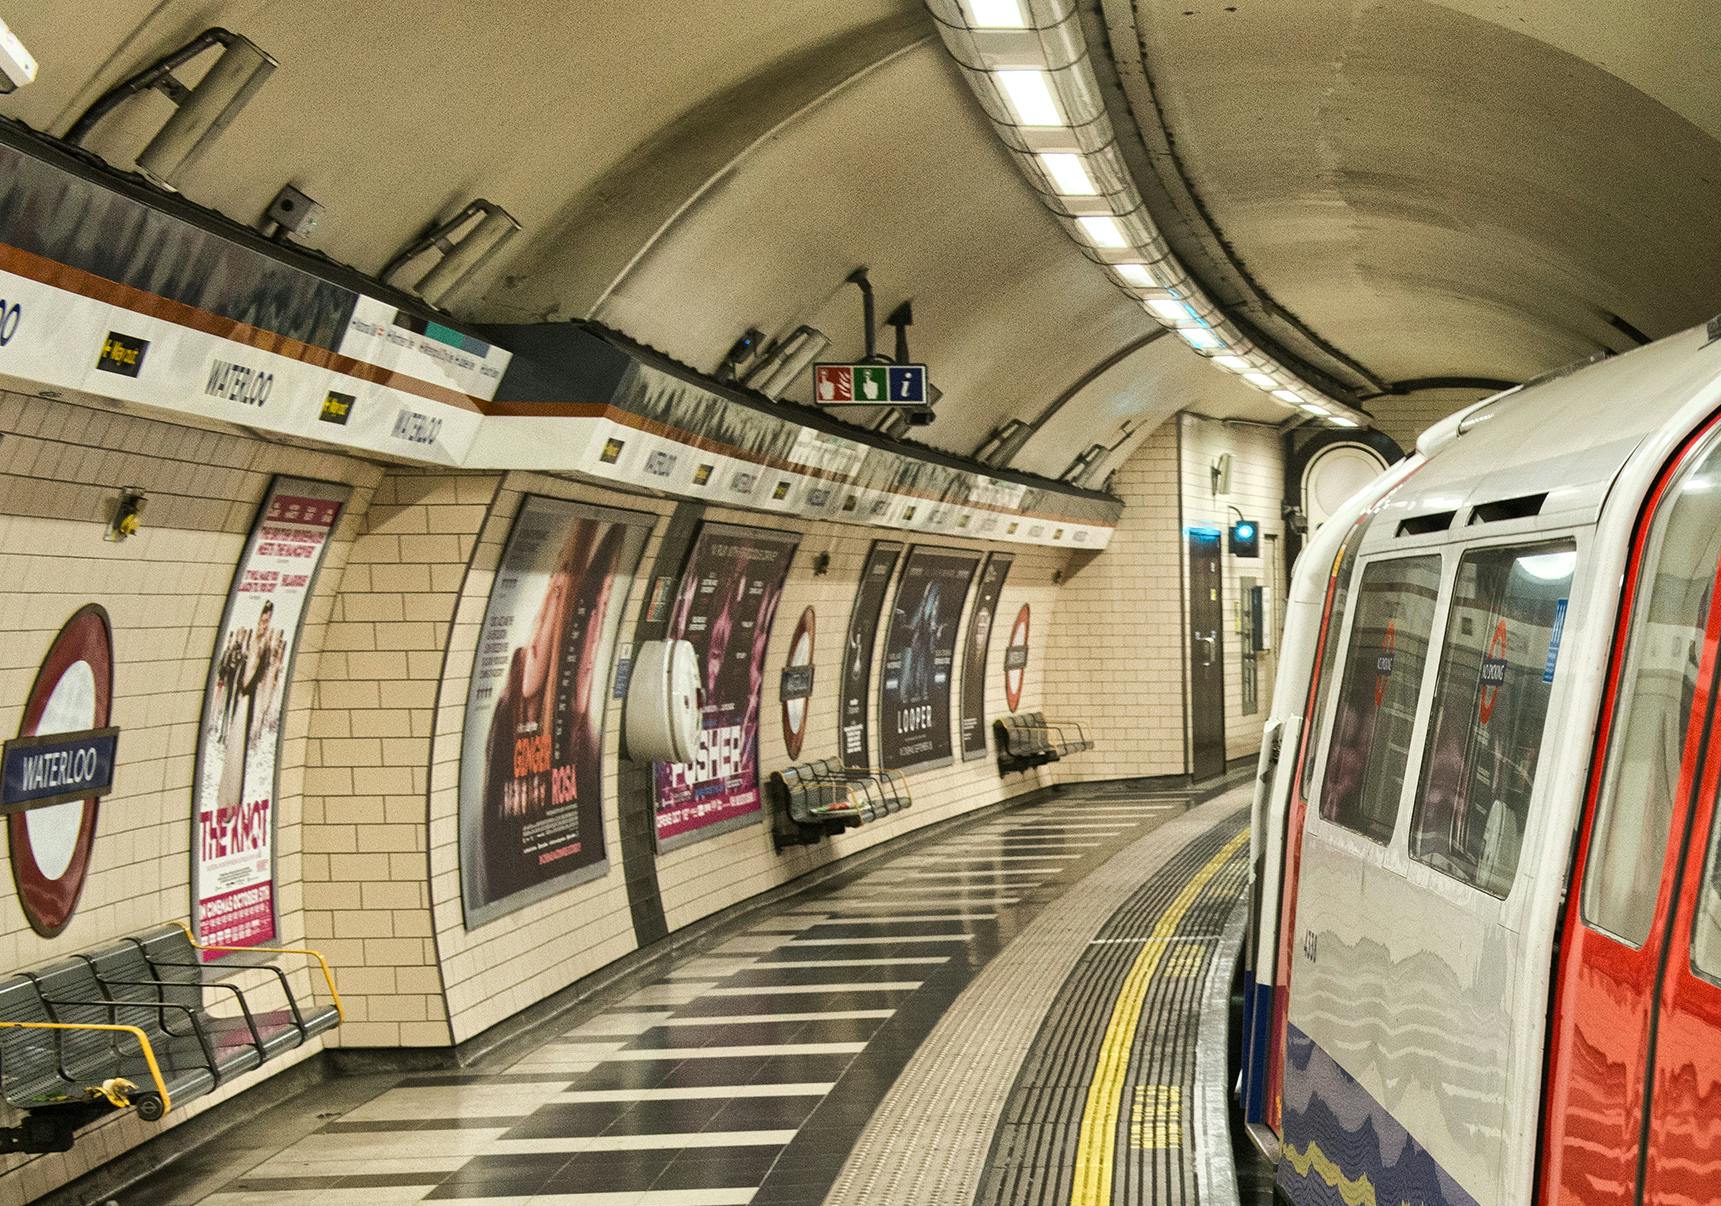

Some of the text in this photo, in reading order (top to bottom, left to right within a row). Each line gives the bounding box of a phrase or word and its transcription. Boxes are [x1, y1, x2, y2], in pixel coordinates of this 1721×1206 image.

[204, 358, 274, 407] WATERLOO
[391, 409, 443, 445] WATERLOO
[897, 705, 932, 734] LOOPER
[22, 746, 97, 791] WATERLOO
[514, 734, 552, 778] GINGER
[551, 764, 578, 805] ROSA
[200, 798, 270, 862] THE KNOT
